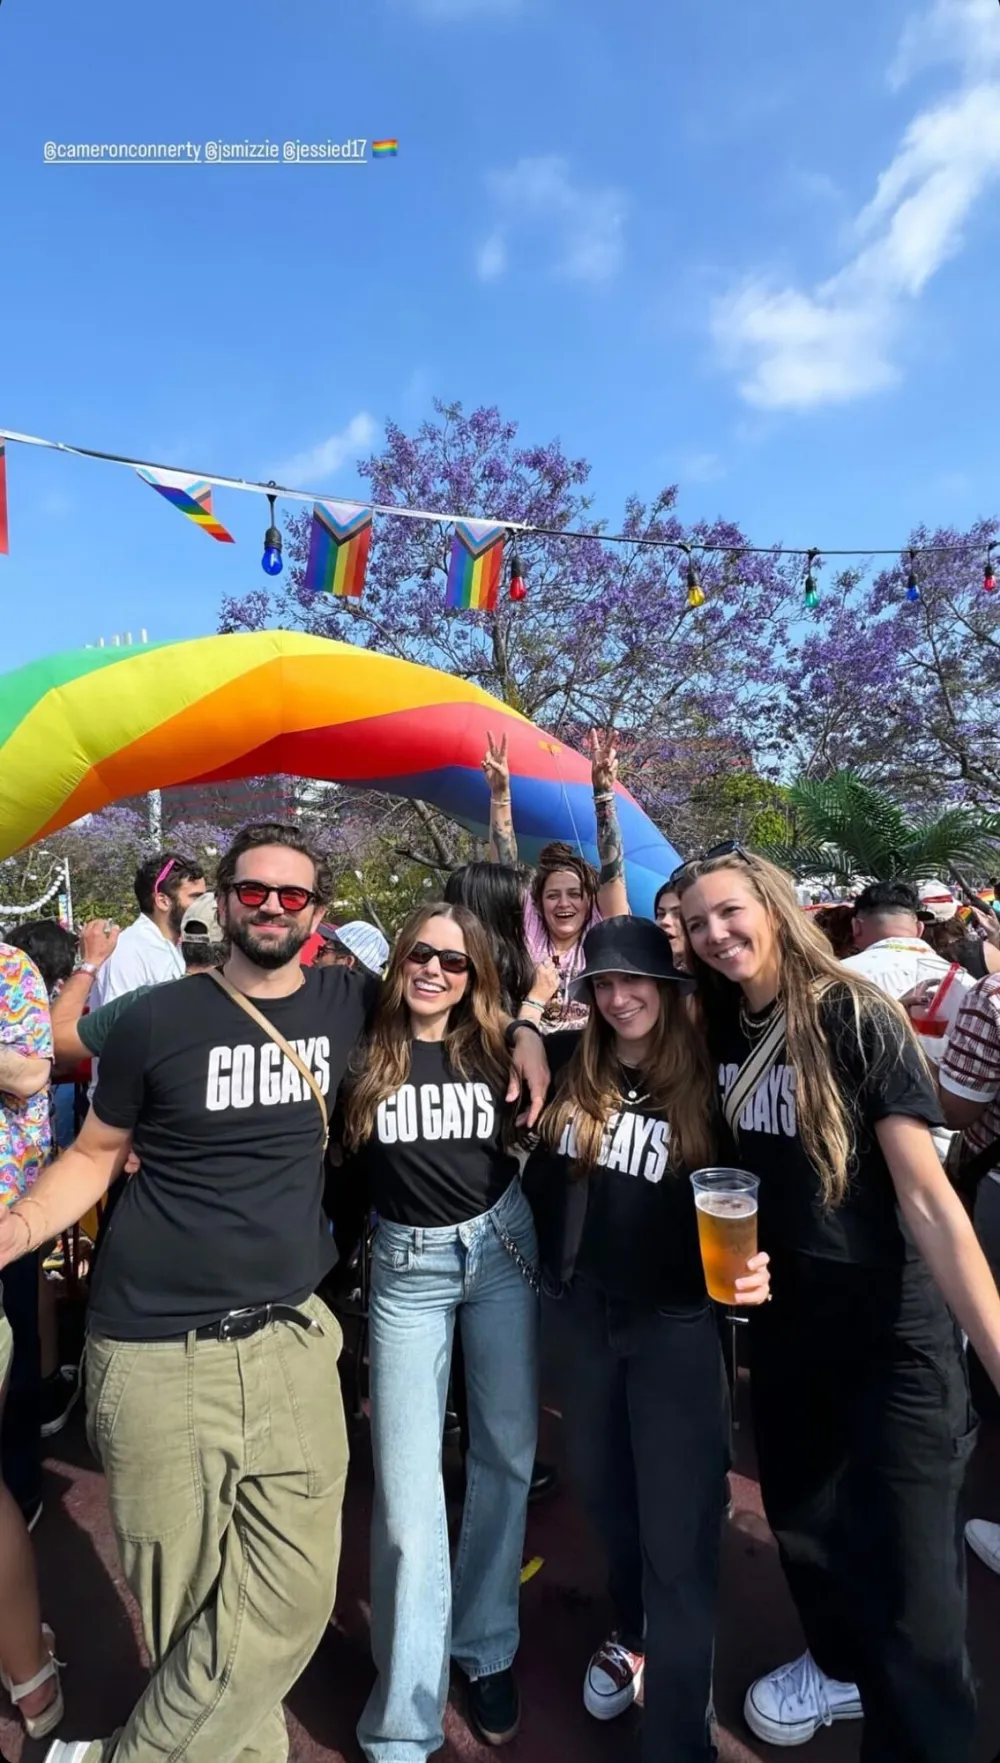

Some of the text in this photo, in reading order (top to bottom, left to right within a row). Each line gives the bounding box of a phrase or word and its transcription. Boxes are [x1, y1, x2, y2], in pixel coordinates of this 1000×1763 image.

[205, 1036, 330, 1111] GO GAYS
[377, 1083, 418, 1144] GO
[420, 1082, 495, 1140] GAYS
